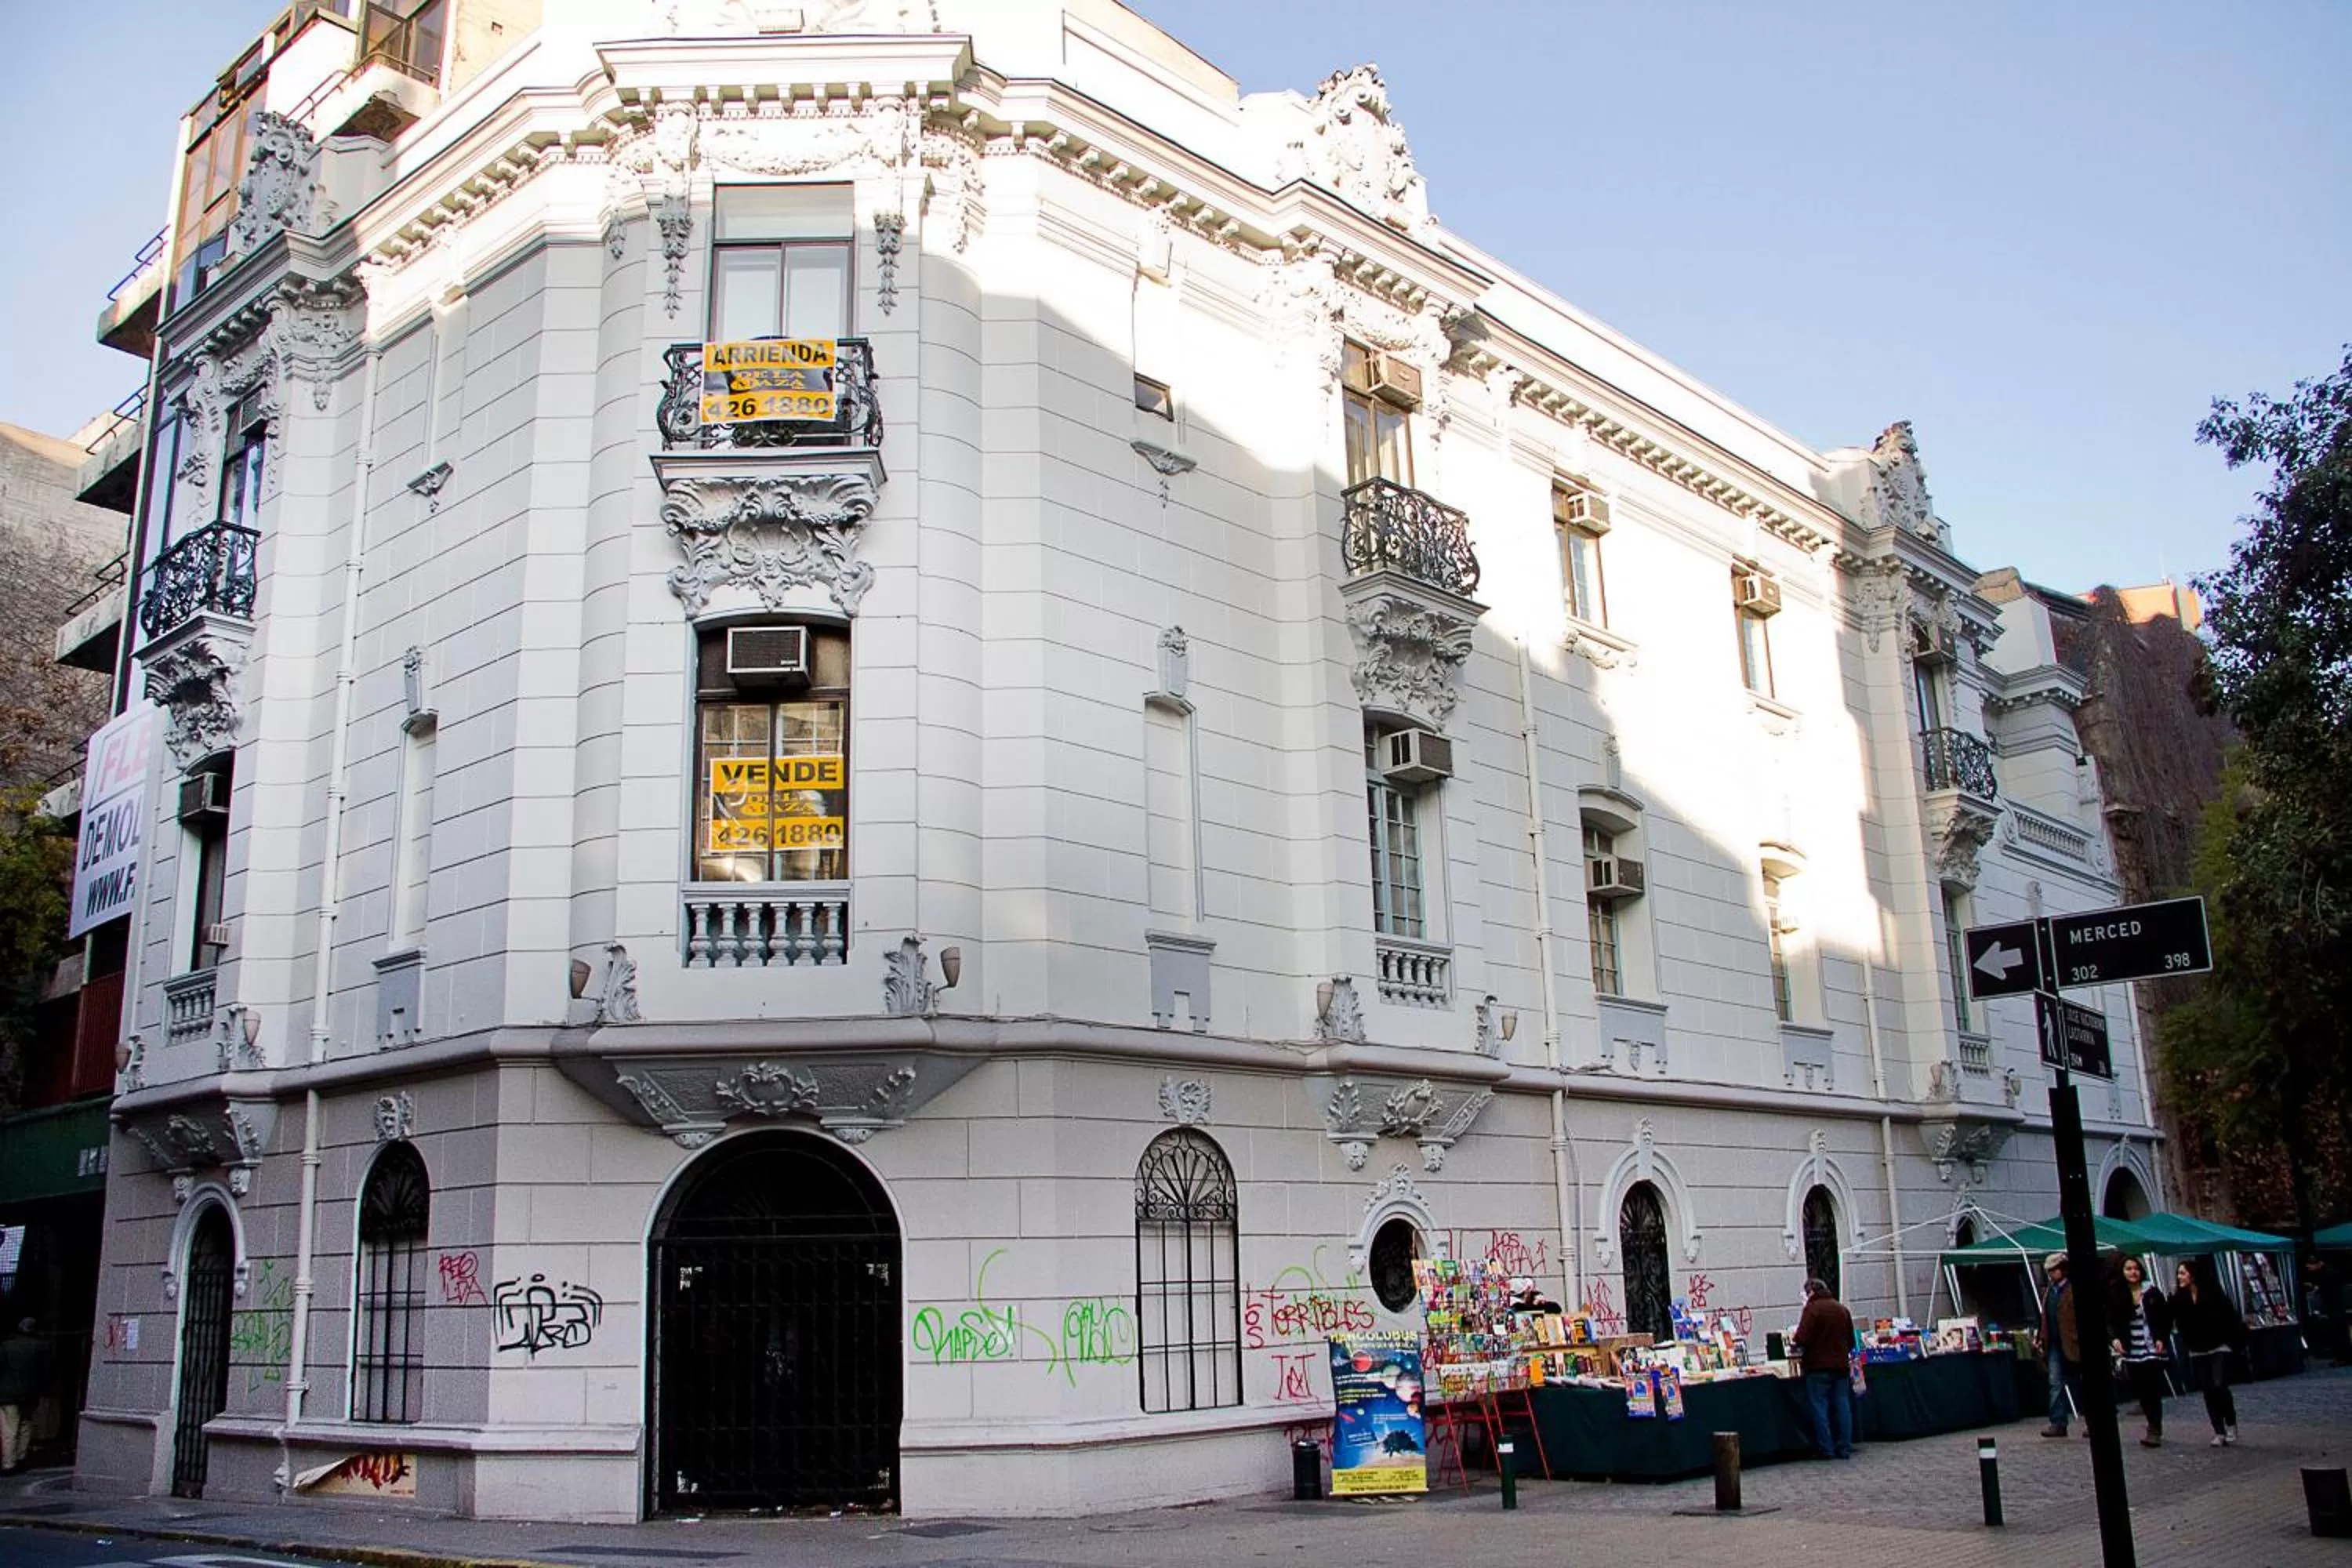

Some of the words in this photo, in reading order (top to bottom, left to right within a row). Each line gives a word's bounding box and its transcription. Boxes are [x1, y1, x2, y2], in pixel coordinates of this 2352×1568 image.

[713, 343, 827, 365] ARRIENDA
[707, 397, 756, 418] 426
[764, 396, 829, 415] 1880
[721, 761, 837, 782] VENDE
[82, 793, 141, 873] DEMOL
[717, 826, 768, 846] 426
[775, 824, 840, 844] 1880
[85, 861, 137, 918] WWW.F
[2069, 920, 2142, 945] MERCED
[2071, 964, 2099, 982] 302
[2164, 953, 2190, 970] 398
